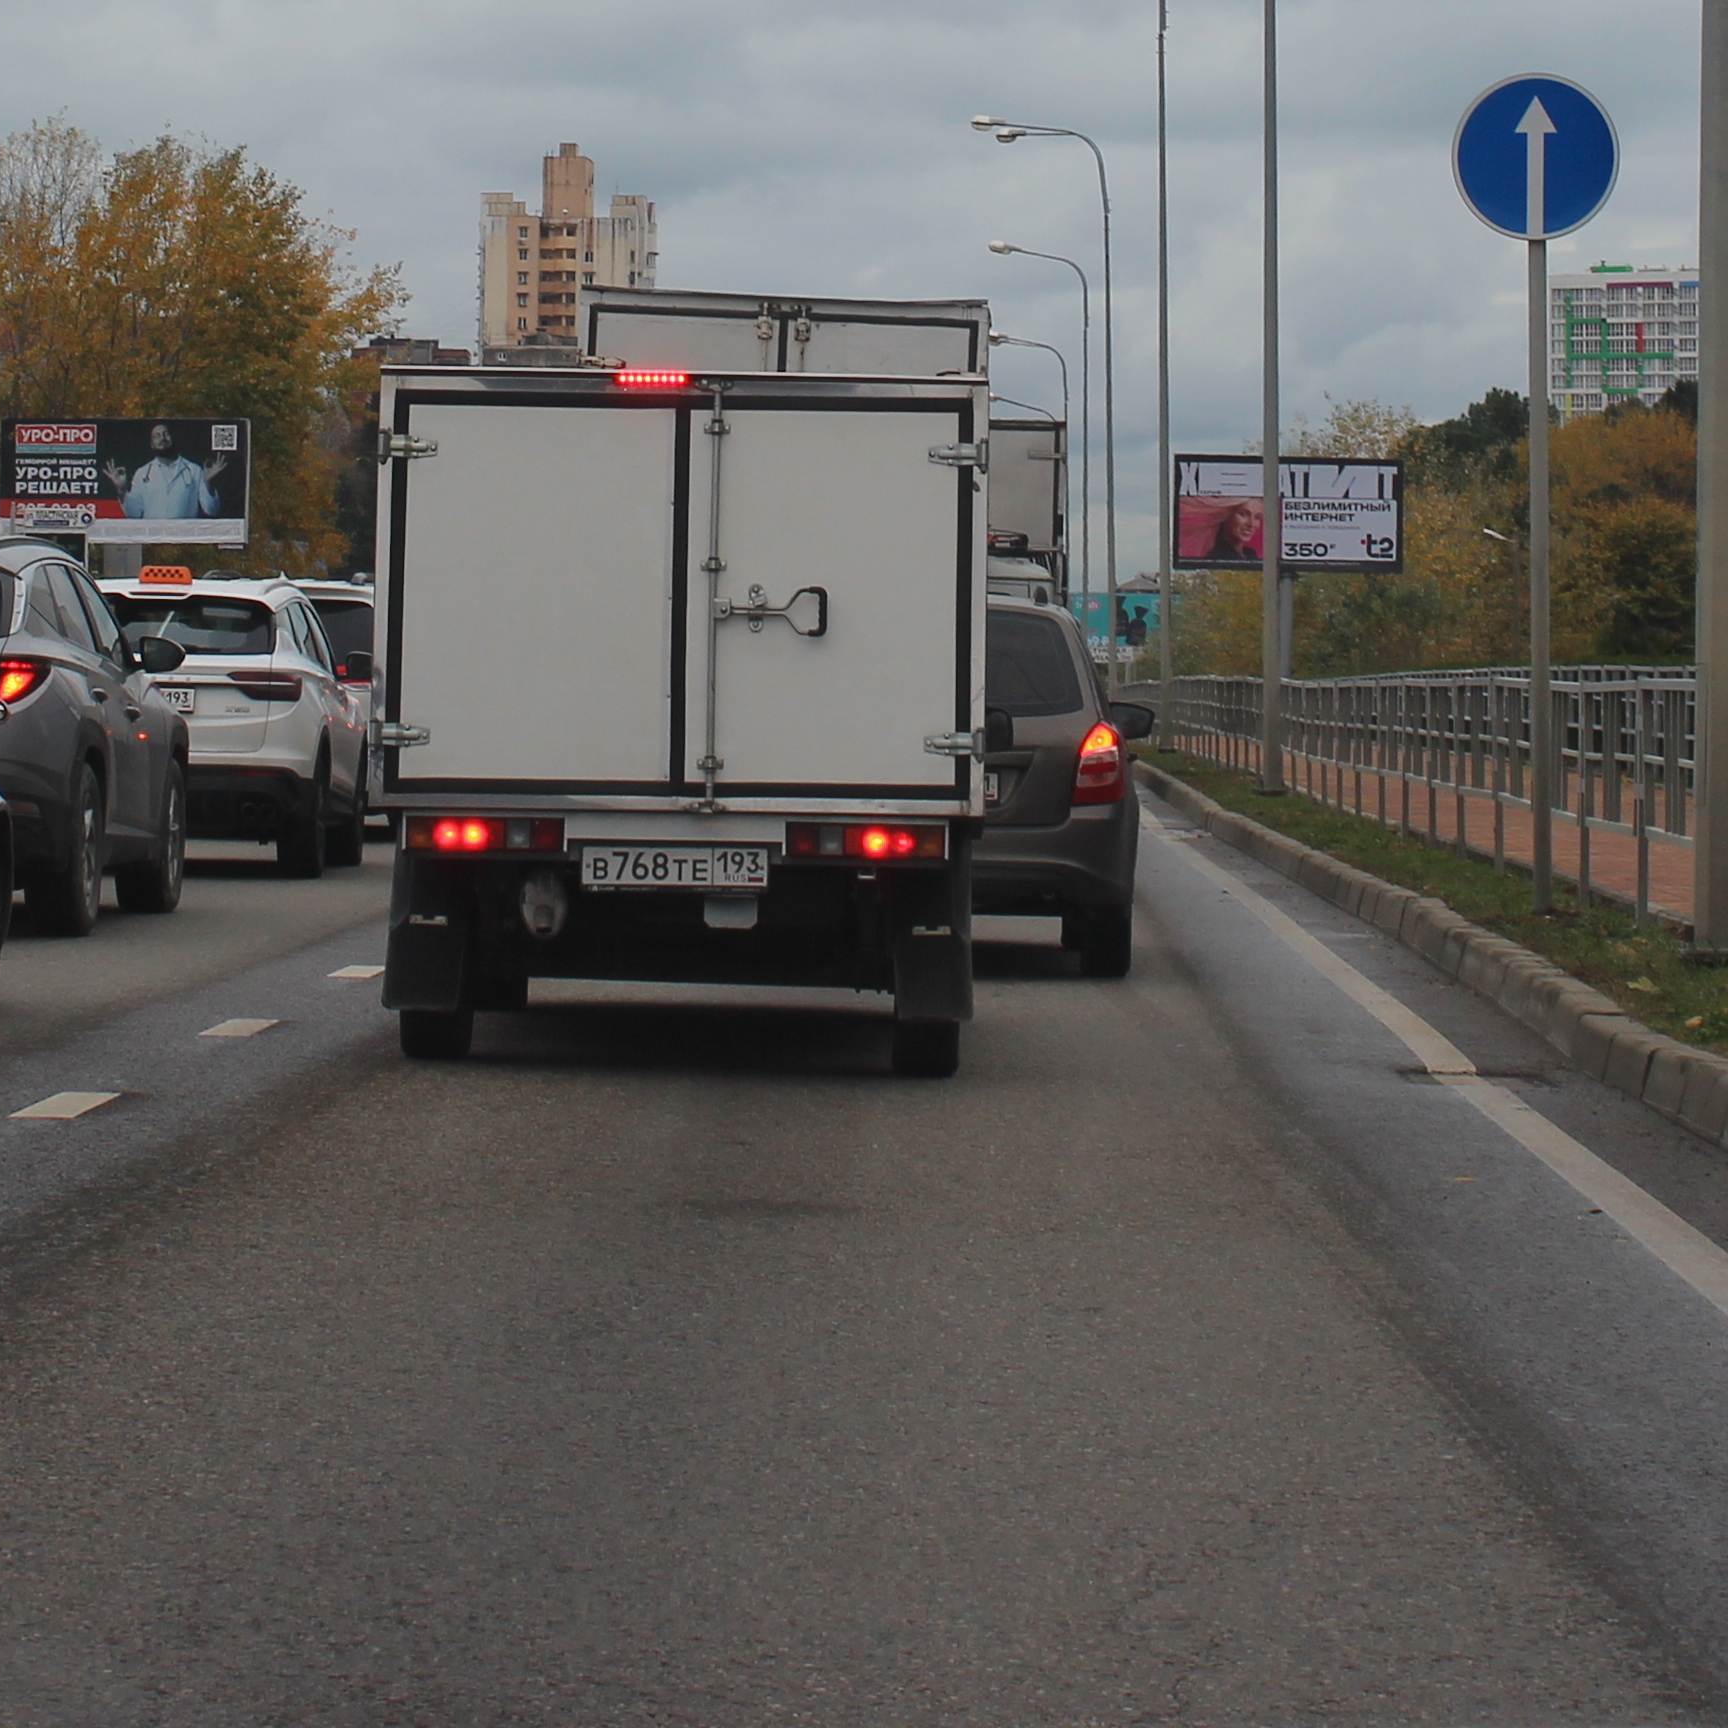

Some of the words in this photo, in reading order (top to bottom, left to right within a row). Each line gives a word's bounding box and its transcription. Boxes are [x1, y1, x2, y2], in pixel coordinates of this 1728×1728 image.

[20, 426, 94, 443] УРО-ПРО
[15, 466, 98, 480] УРО-ПРО
[15, 481, 99, 494] РЕШАЕТ!
[1284, 501, 1392, 513] БЕЗЛИМИТНЫЙ
[1283, 512, 1356, 523] ИНТЕРНЕТ
[1365, 533, 1395, 559] t2
[716, 851, 761, 874] 193
[724, 874, 747, 883] RUS
